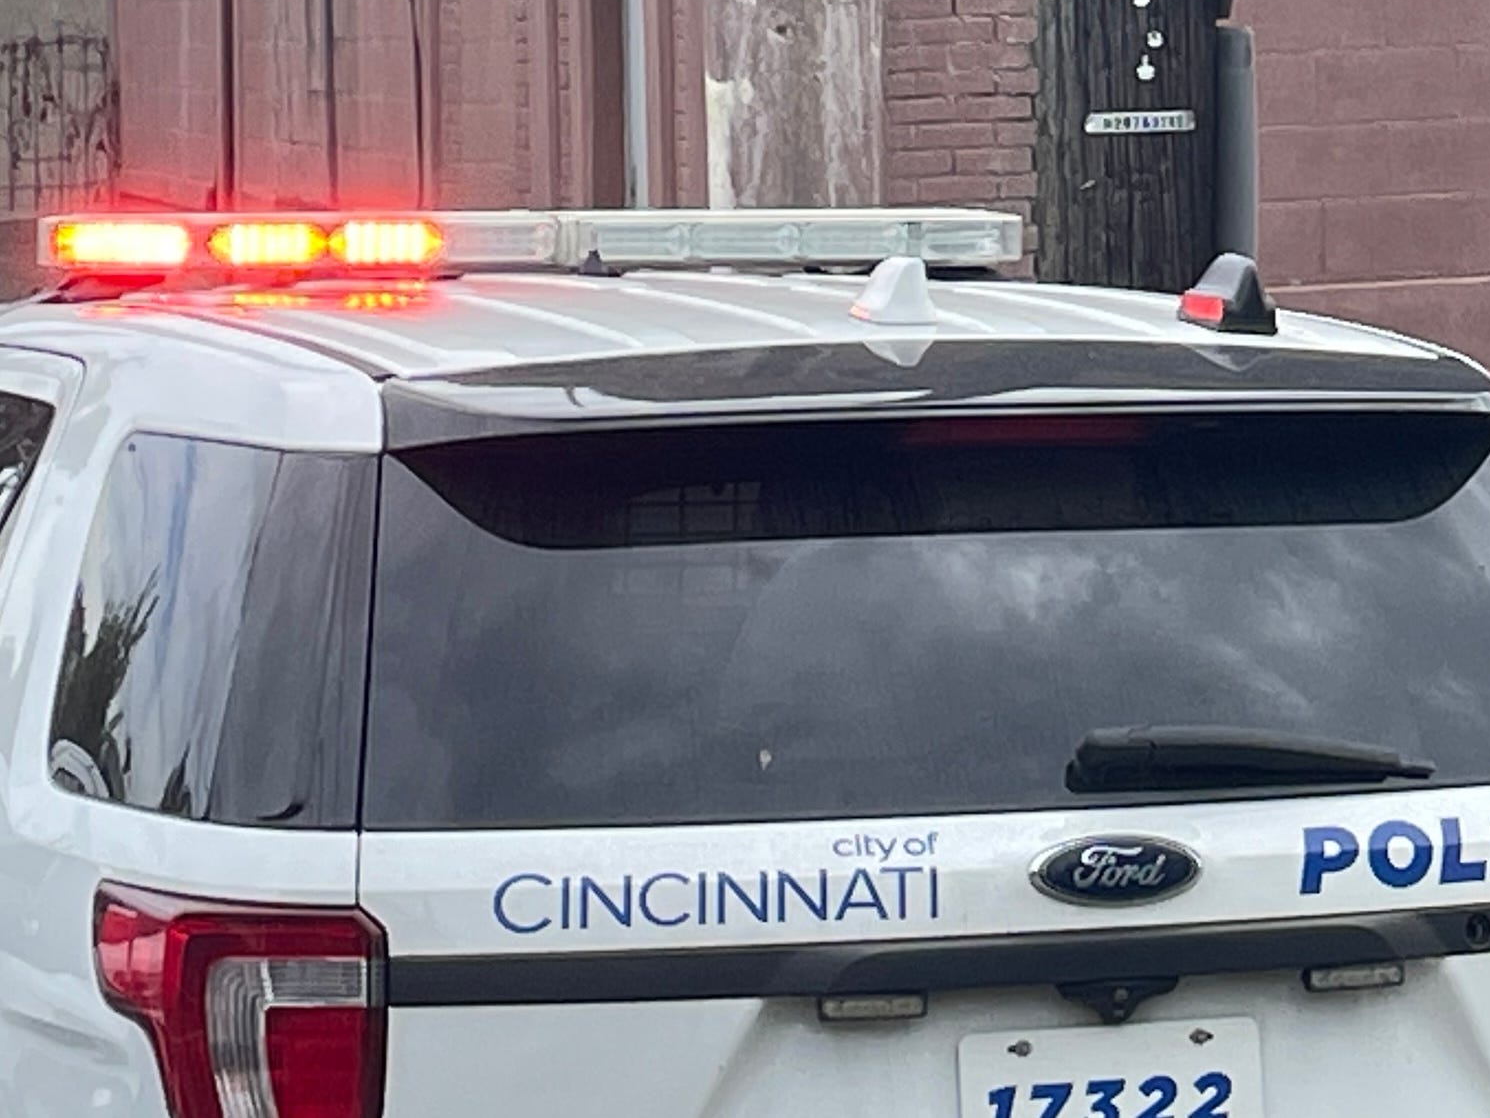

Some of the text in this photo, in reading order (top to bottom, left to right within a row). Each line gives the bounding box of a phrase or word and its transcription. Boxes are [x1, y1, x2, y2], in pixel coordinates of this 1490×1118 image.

[832, 831, 938, 862] city of
[1072, 844, 1167, 888] Ford
[492, 865, 938, 934] CINCINNATI
[986, 1071, 1233, 1118] 17322
